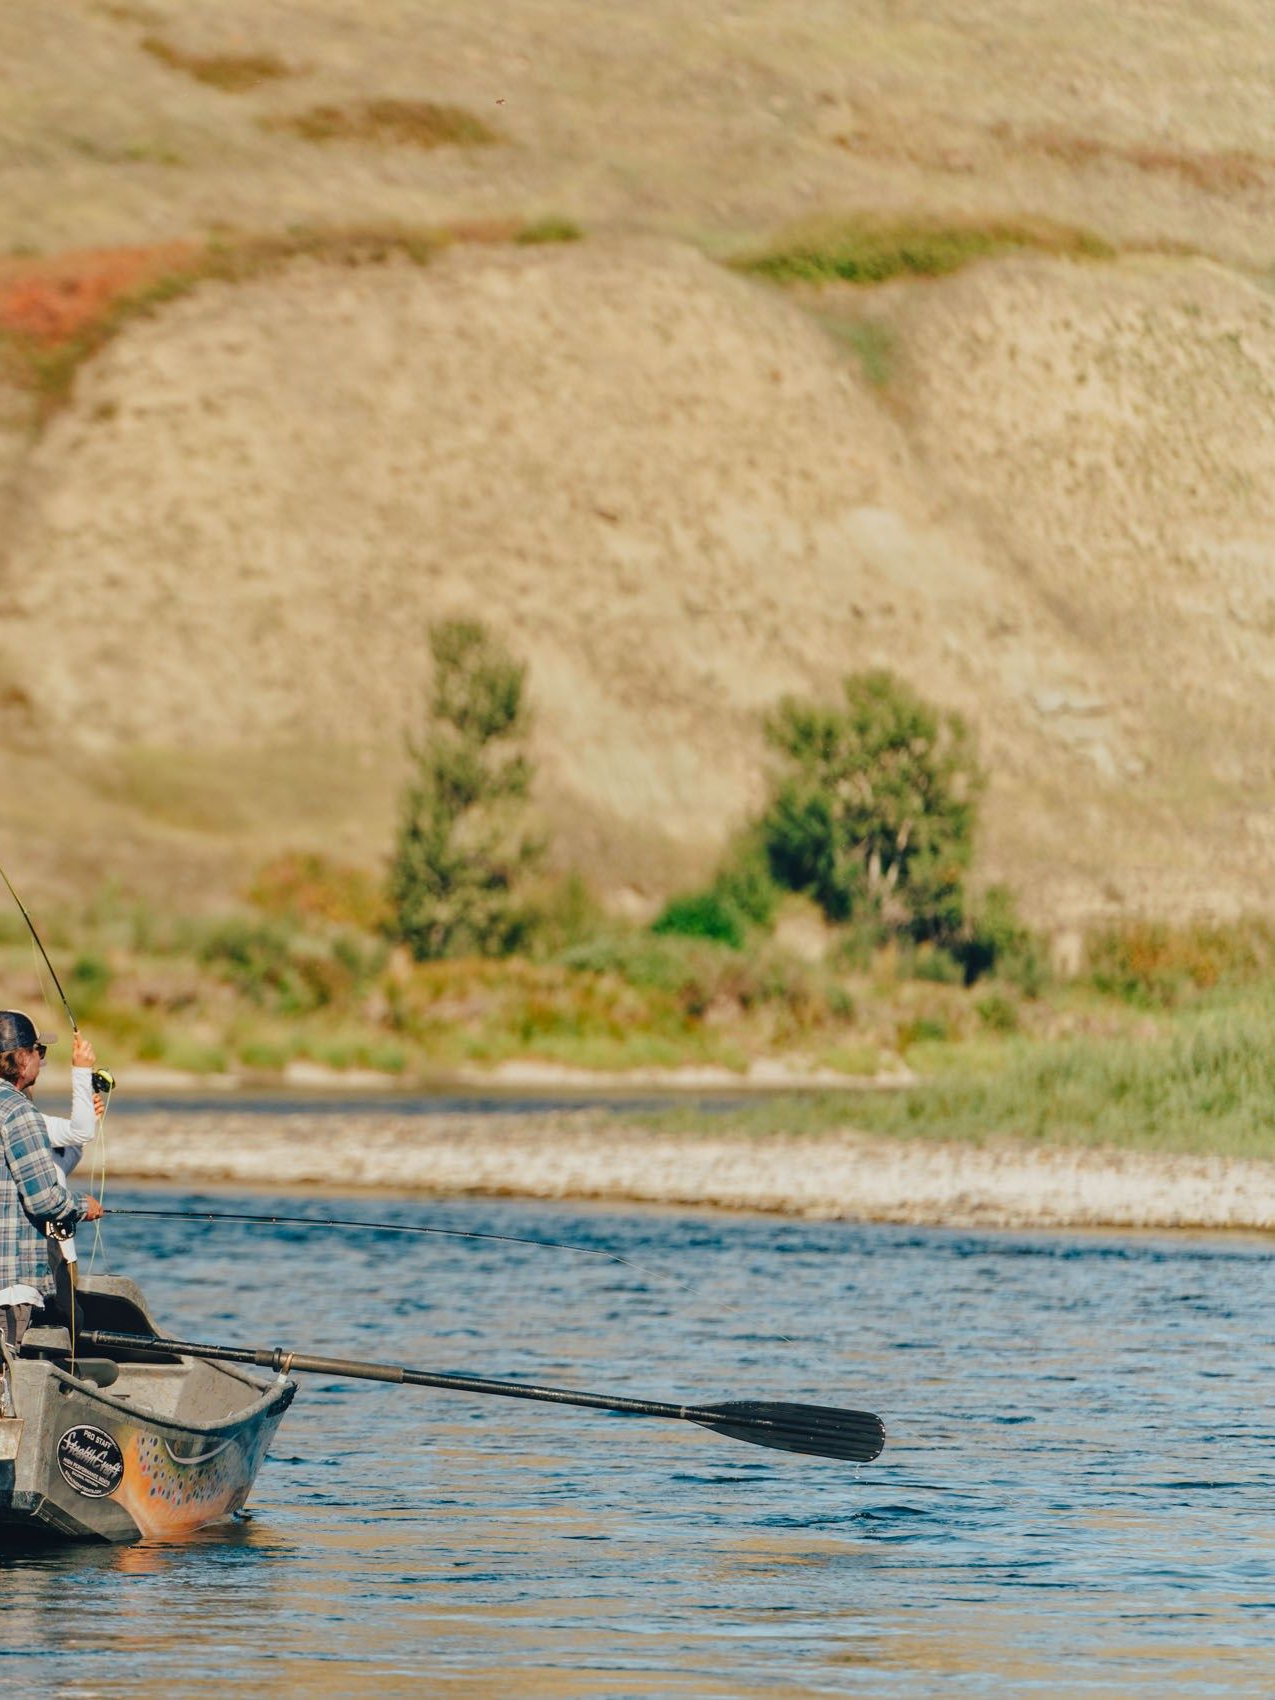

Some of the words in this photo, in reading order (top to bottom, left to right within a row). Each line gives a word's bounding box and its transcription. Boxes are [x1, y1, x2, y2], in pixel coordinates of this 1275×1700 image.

[83, 1430, 96, 1441] PRO
[95, 1436, 113, 1449] STAFF
[72, 1461, 100, 1480] PERFORMANCE
